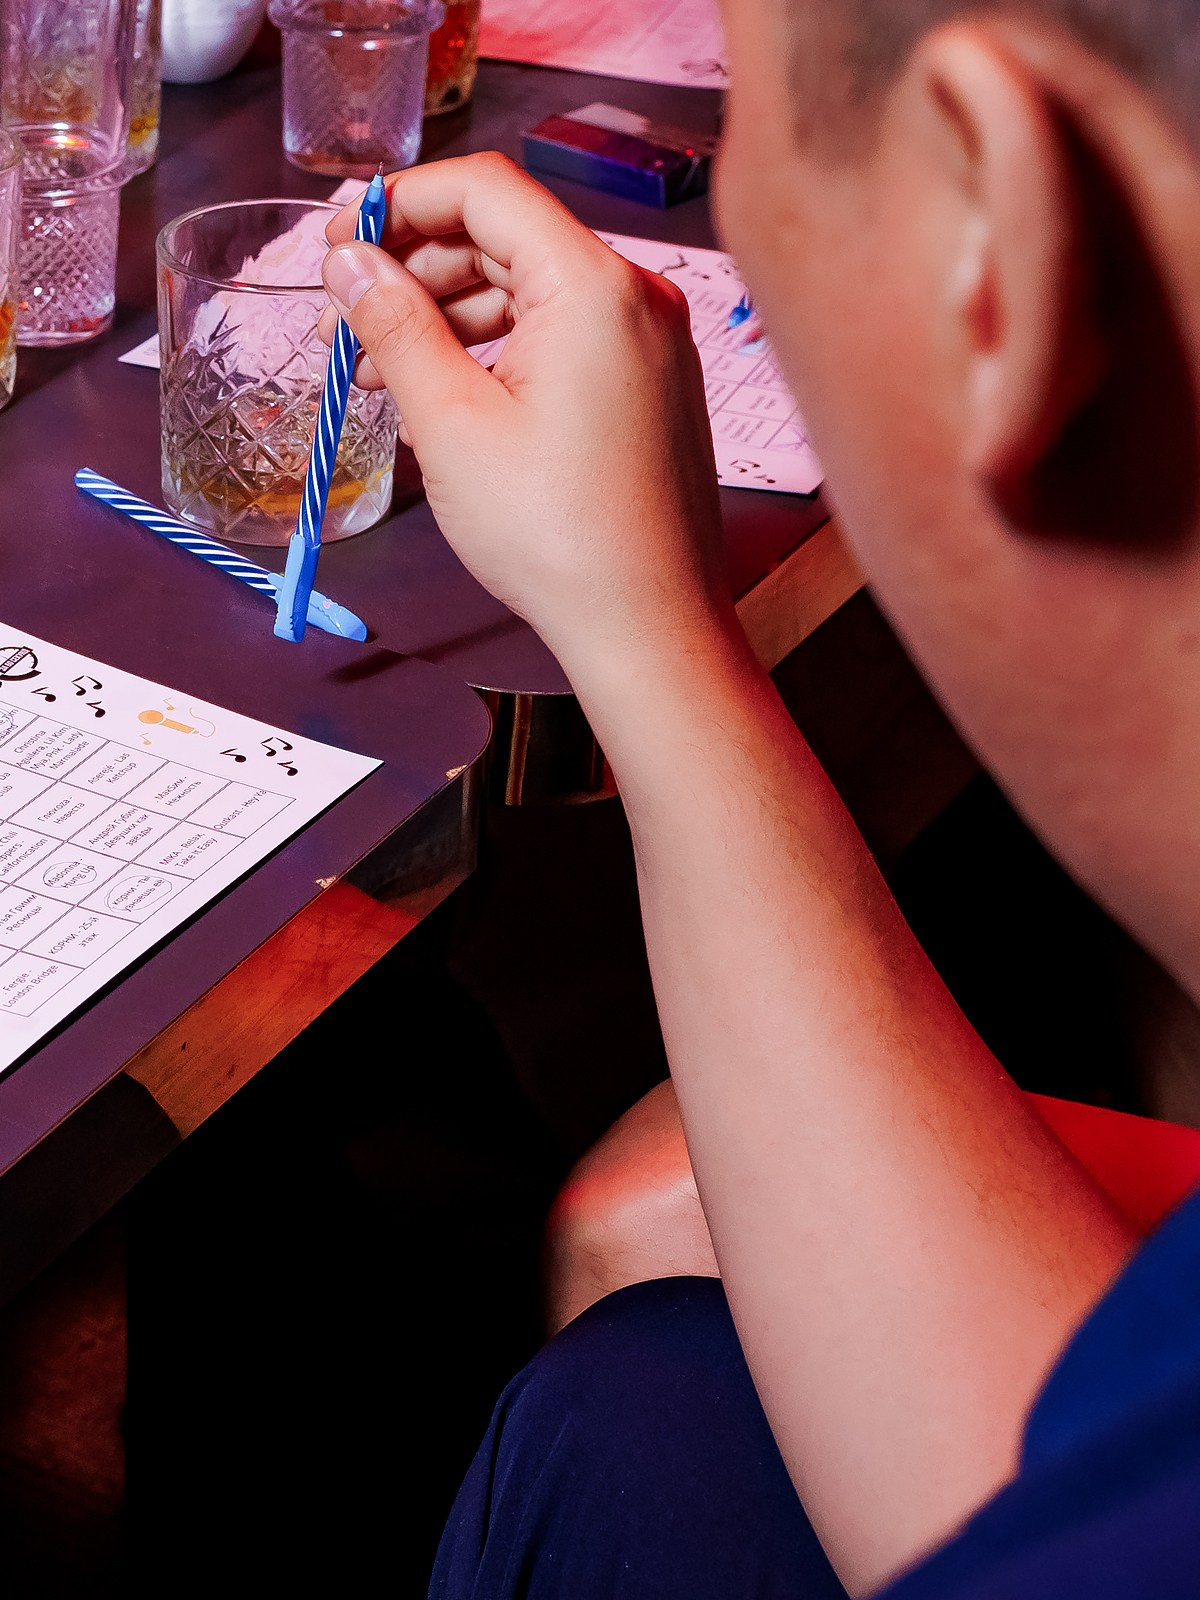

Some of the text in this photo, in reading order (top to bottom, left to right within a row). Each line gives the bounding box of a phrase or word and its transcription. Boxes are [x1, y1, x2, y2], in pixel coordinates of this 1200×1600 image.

[13, 730, 47, 754] Christina
[15, 745, 49, 767] Aguilera,
[42, 736, 56, 745] Lil
[29, 758, 51, 771] Mya,
[62, 730, 84, 745] Lady
[48, 740, 90, 770] Marmalade
[113, 752, 130, 763] Las
[105, 762, 137, 784] Ketchup
[164, 781, 202, 807] Нежность
[52, 802, 85, 825] Невеста
[212, 809, 243, 832] Outkast
[240, 796, 260, 808] Hey
[253, 789, 267, 797] Ya
[88, 807, 138, 845] Андрей Губин
[103, 822, 138, 849] Девушки
[135, 813, 148, 824] как
[158, 851, 182, 866] MIKA
[173, 854, 196, 868] Take
[196, 837, 218, 851] Easy
[43, 861, 81, 888] Madonna
[60, 864, 96, 889] Hung Up
[111, 886, 137, 905] корни
[137, 874, 151, 884] ты
[8, 894, 38, 914] Гримм
[5, 905, 43, 932] Ресницы
[47, 932, 79, 955] КОРНИ
[77, 932, 99, 947] этаж
[1, 972, 30, 992] Fergie
[2, 964, 59, 1008] London Bridge
